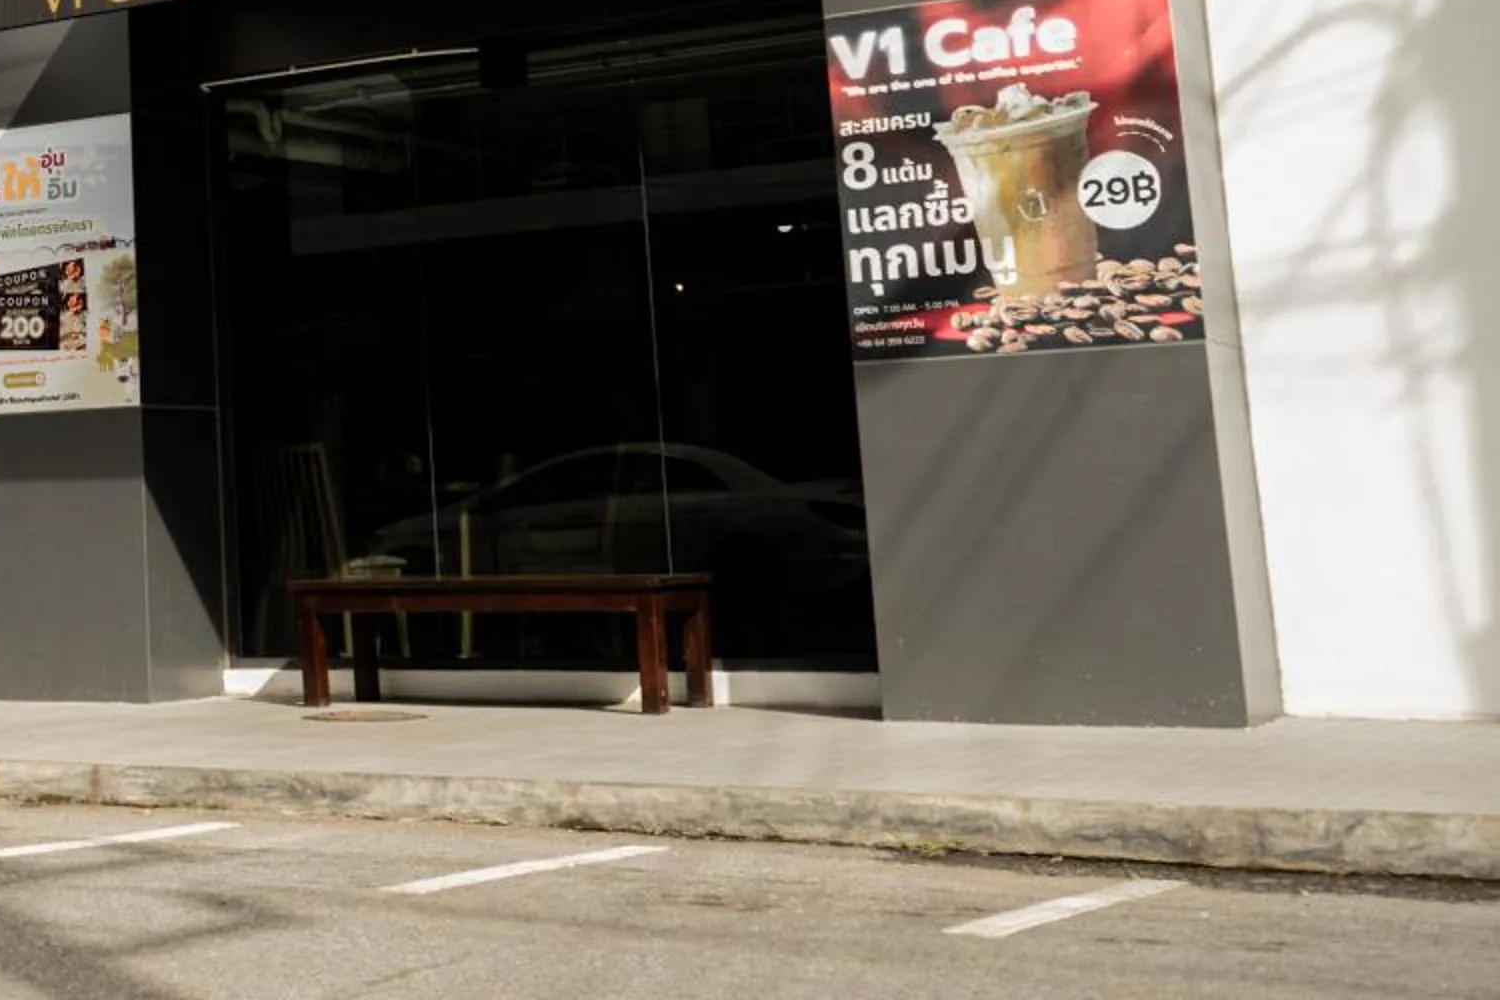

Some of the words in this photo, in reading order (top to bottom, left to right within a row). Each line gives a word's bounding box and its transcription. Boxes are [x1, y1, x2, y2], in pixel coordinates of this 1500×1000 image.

[830, 26, 906, 80] V1
[922, 5, 1078, 68] Cafe
[839, 112, 932, 137] สะสมครบ
[842, 141, 878, 191] 8
[881, 157, 933, 185] แต้ม
[847, 178, 974, 235] แลกซื้อ
[849, 235, 1018, 297] ทุกเมนู
[0, 315, 45, 339] 200
